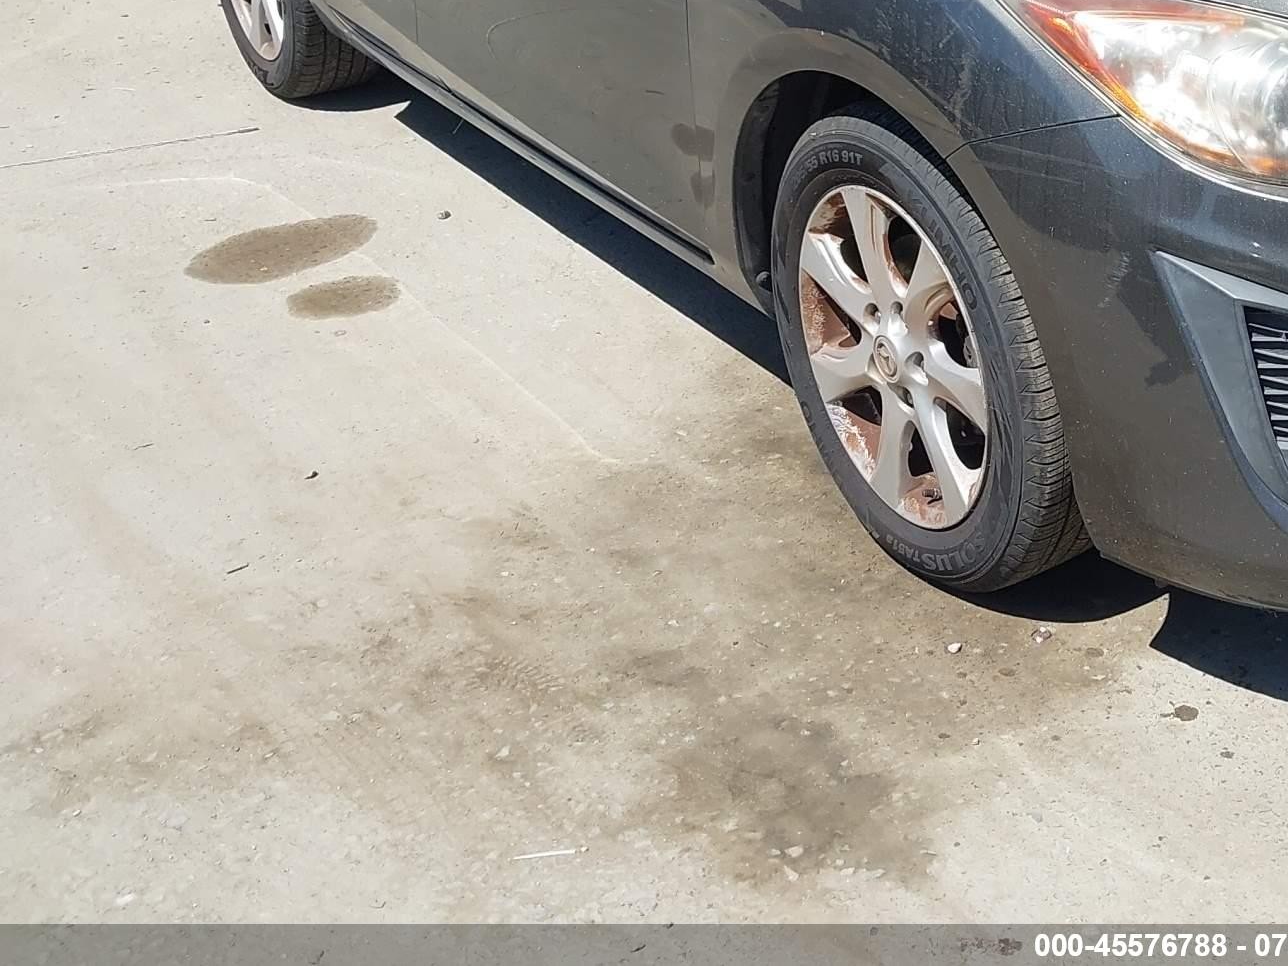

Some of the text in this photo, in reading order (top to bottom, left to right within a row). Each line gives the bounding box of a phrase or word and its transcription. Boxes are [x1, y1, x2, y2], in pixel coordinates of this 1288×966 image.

[819, 149, 840, 165] R16
[841, 150, 863, 166] 91T
[920, 531, 985, 571] SOLUS
